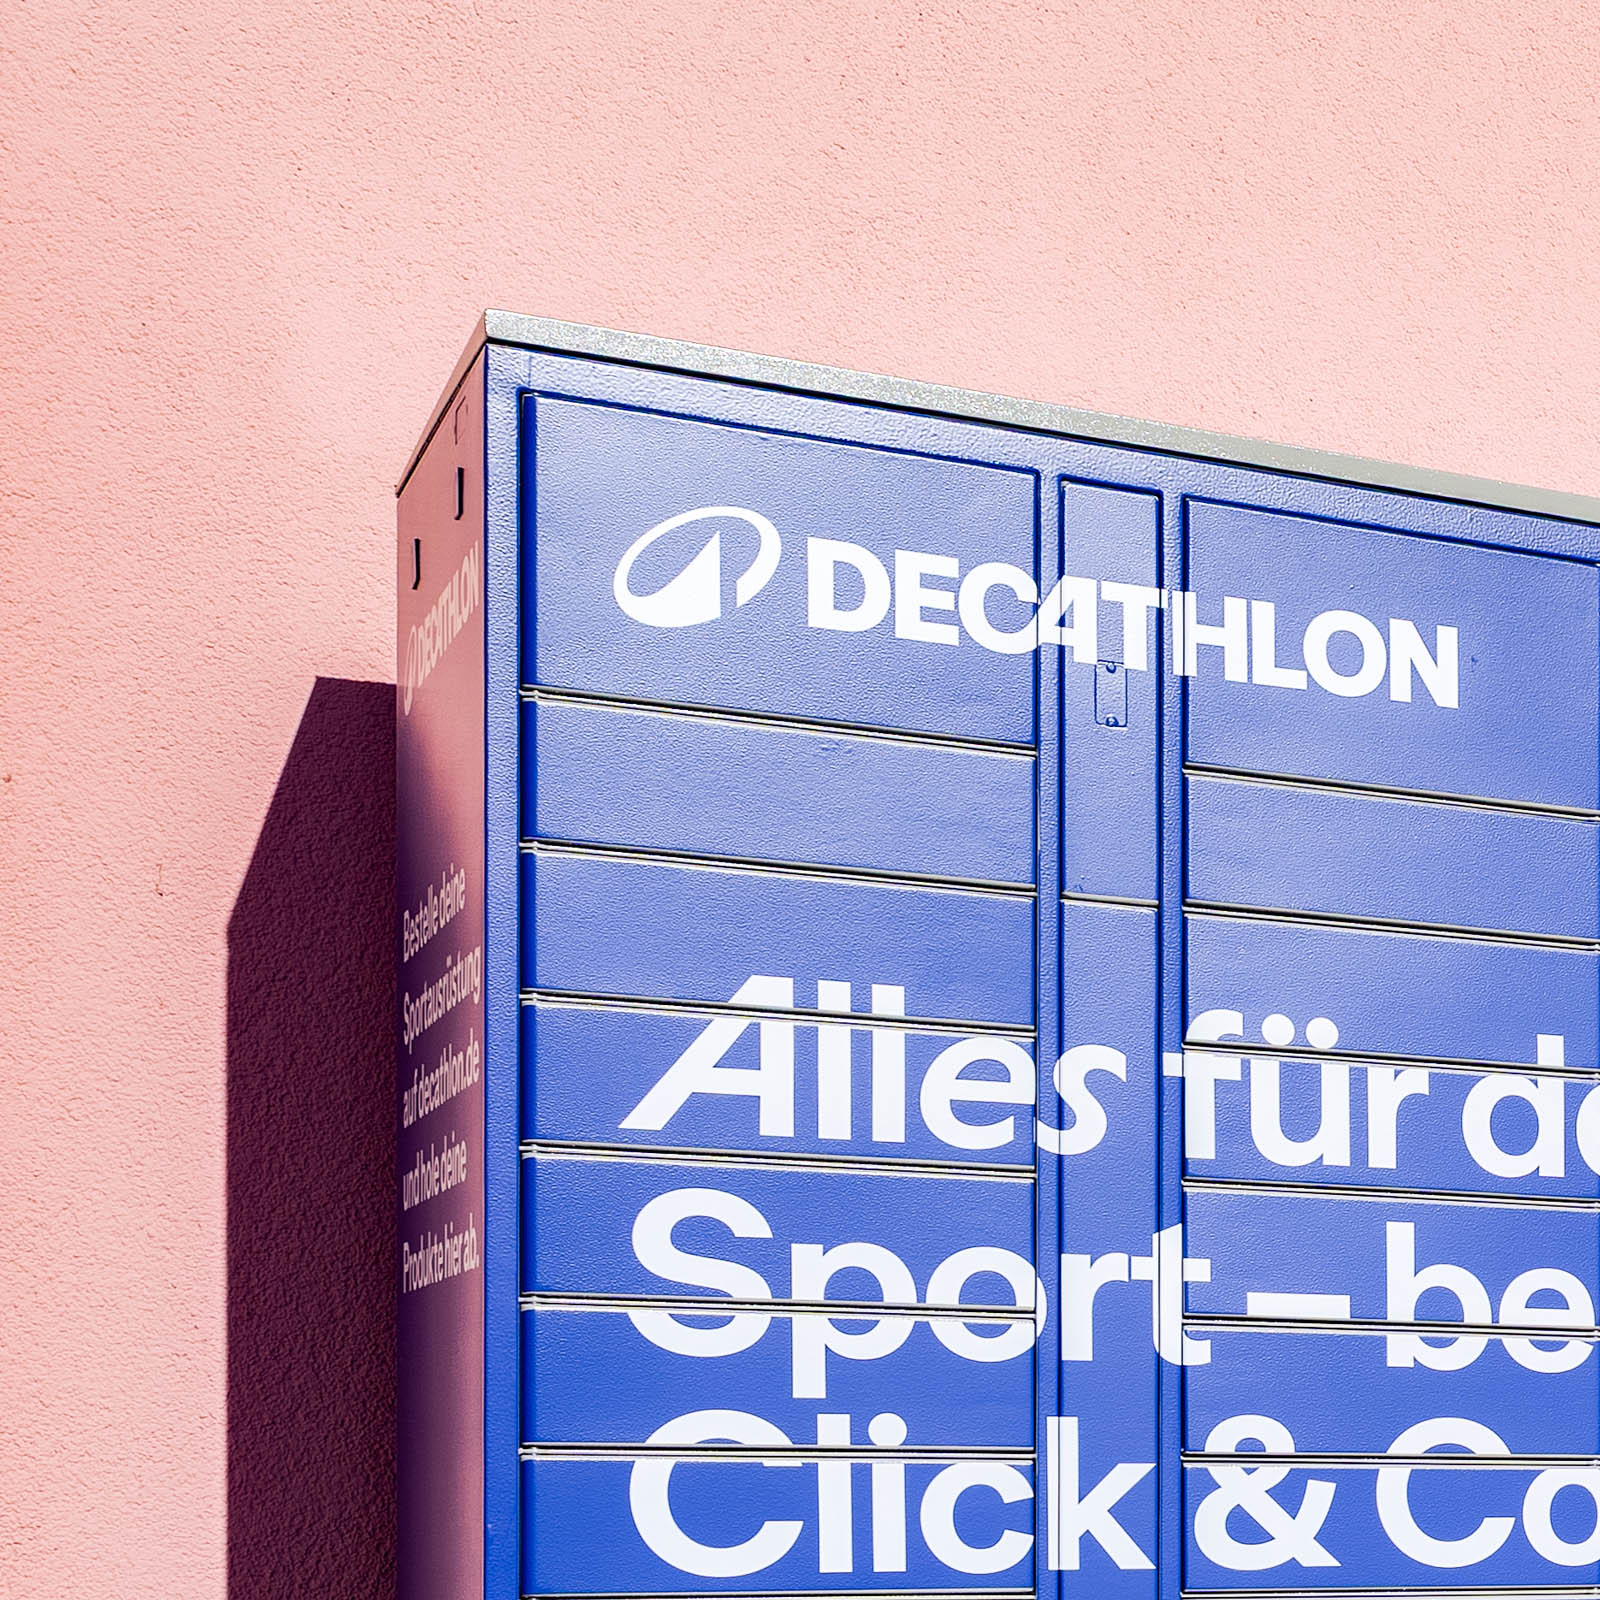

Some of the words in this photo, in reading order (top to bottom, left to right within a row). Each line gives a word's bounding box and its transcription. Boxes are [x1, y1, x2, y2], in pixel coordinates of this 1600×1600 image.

[417, 540, 479, 688] DECATHLON
[806, 536, 1460, 709] DECATHLON
[403, 884, 439, 962] Bestelle
[439, 862, 465, 928] deine
[403, 945, 481, 1055] Sportausrüstung
[403, 1068, 418, 1129] auf
[418, 1027, 480, 1119] decathlon.de
[618, 975, 1127, 1156] Alles
[1162, 1008, 1430, 1169] für
[403, 1151, 420, 1211] und
[420, 1143, 439, 1202] hole
[440, 1130, 467, 1192] deine
[403, 1231, 443, 1293] Produkte
[444, 1221, 464, 1278] hier
[463, 1212, 480, 1272] ab.
[626, 1187, 1212, 1398] Sport
[629, 1409, 1157, 1578] Click
[1194, 1414, 1343, 1571] &
